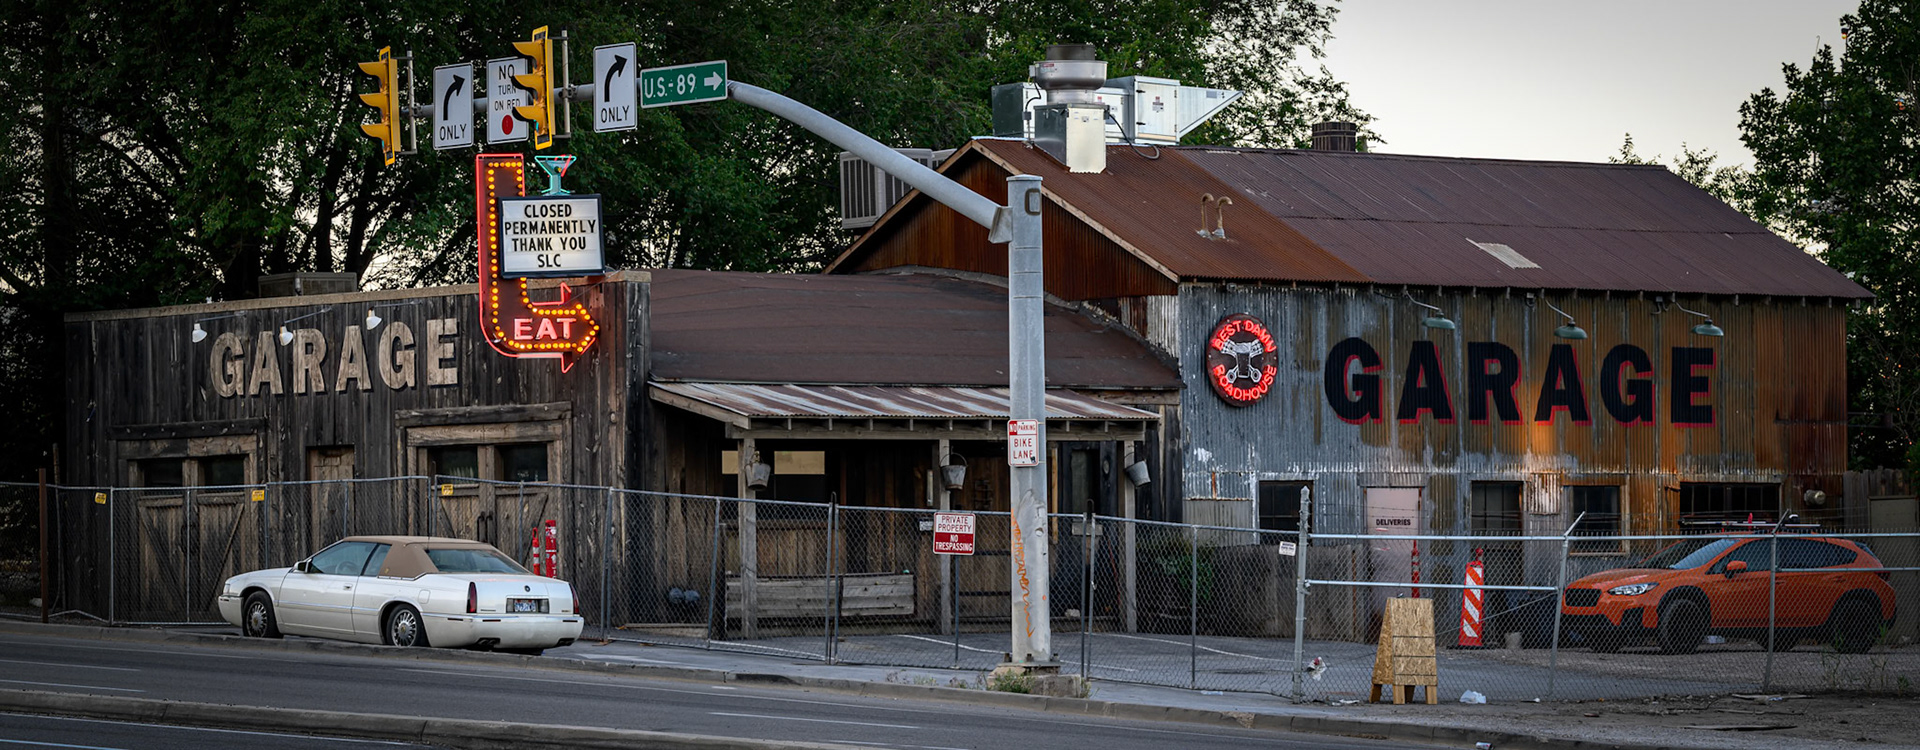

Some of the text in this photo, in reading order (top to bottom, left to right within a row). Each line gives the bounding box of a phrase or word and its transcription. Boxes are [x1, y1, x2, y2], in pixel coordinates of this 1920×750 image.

[498, 63, 515, 80] NO
[498, 84, 517, 96] TURN
[644, 73, 696, 99] U.S.-89
[494, 100, 504, 111] ON
[600, 105, 630, 123] ONLY
[440, 123, 467, 141] ONLY
[524, 204, 572, 218] CLOSED
[504, 219, 597, 236] PERMANENTLY
[512, 236, 587, 252] THANK YOU
[537, 254, 562, 268] SLC
[514, 318, 577, 340] EAT
[1211, 320, 1277, 353] BEST DAMN
[210, 317, 459, 399] GARAGE
[1213, 364, 1277, 401] ROADHOUSE
[1324, 336, 1717, 429] GARAGE
[1009, 422, 1018, 433] NO
[1013, 438, 1033, 448] BIKE
[1013, 449, 1033, 460] LANE
[941, 515, 969, 525] PRIVATE
[1375, 518, 1412, 527] DELIVERIES
[937, 523, 972, 532] PROPERTY
[950, 534, 959, 543] NO
[936, 541, 973, 552] TRESPASSING
